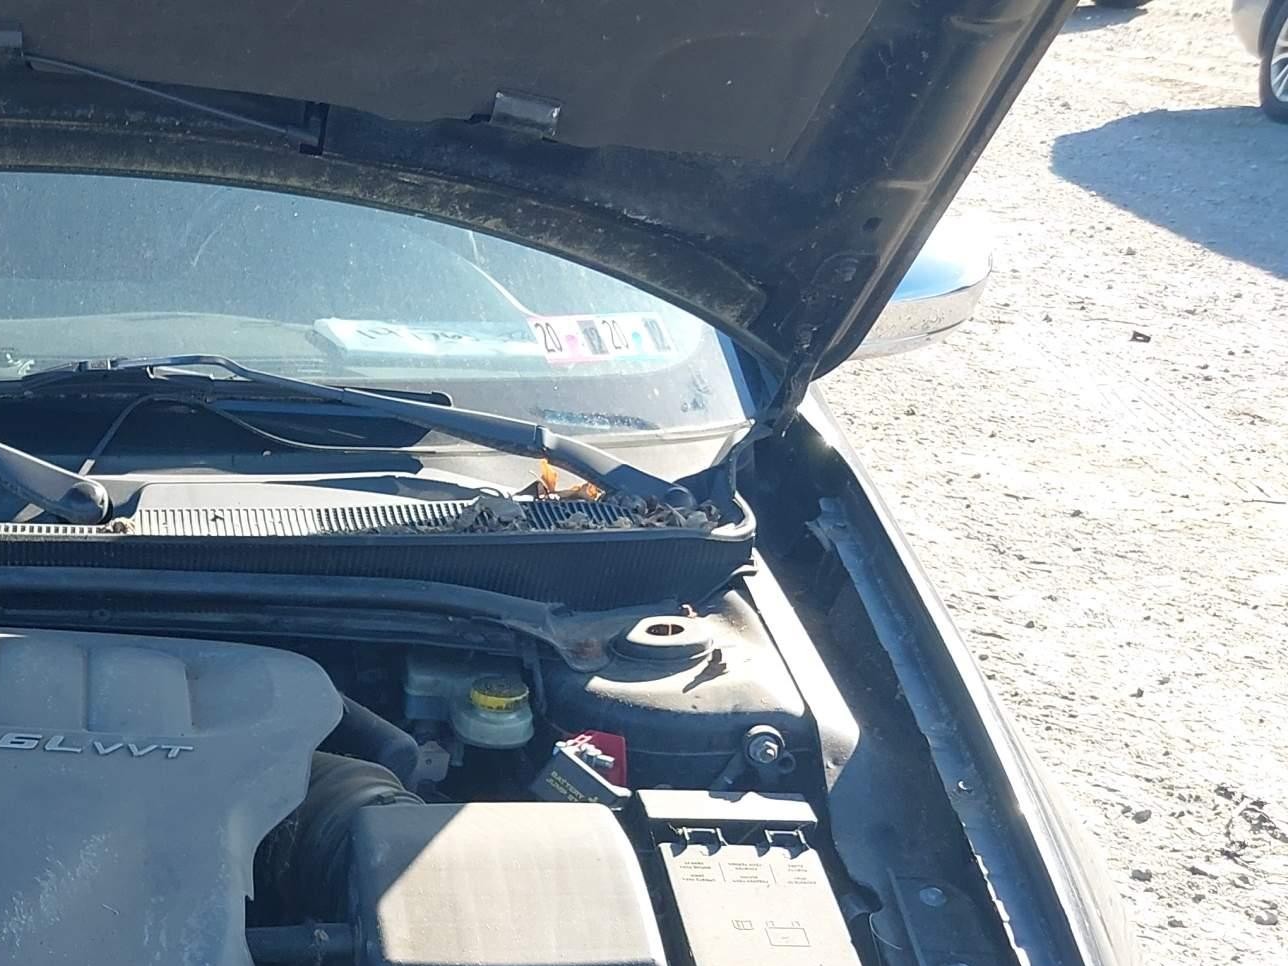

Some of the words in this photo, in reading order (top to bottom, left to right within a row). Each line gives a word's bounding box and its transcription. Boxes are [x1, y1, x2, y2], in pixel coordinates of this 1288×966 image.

[534, 322, 563, 353] 20
[601, 319, 629, 350] 20
[94, 740, 194, 759] VVT
